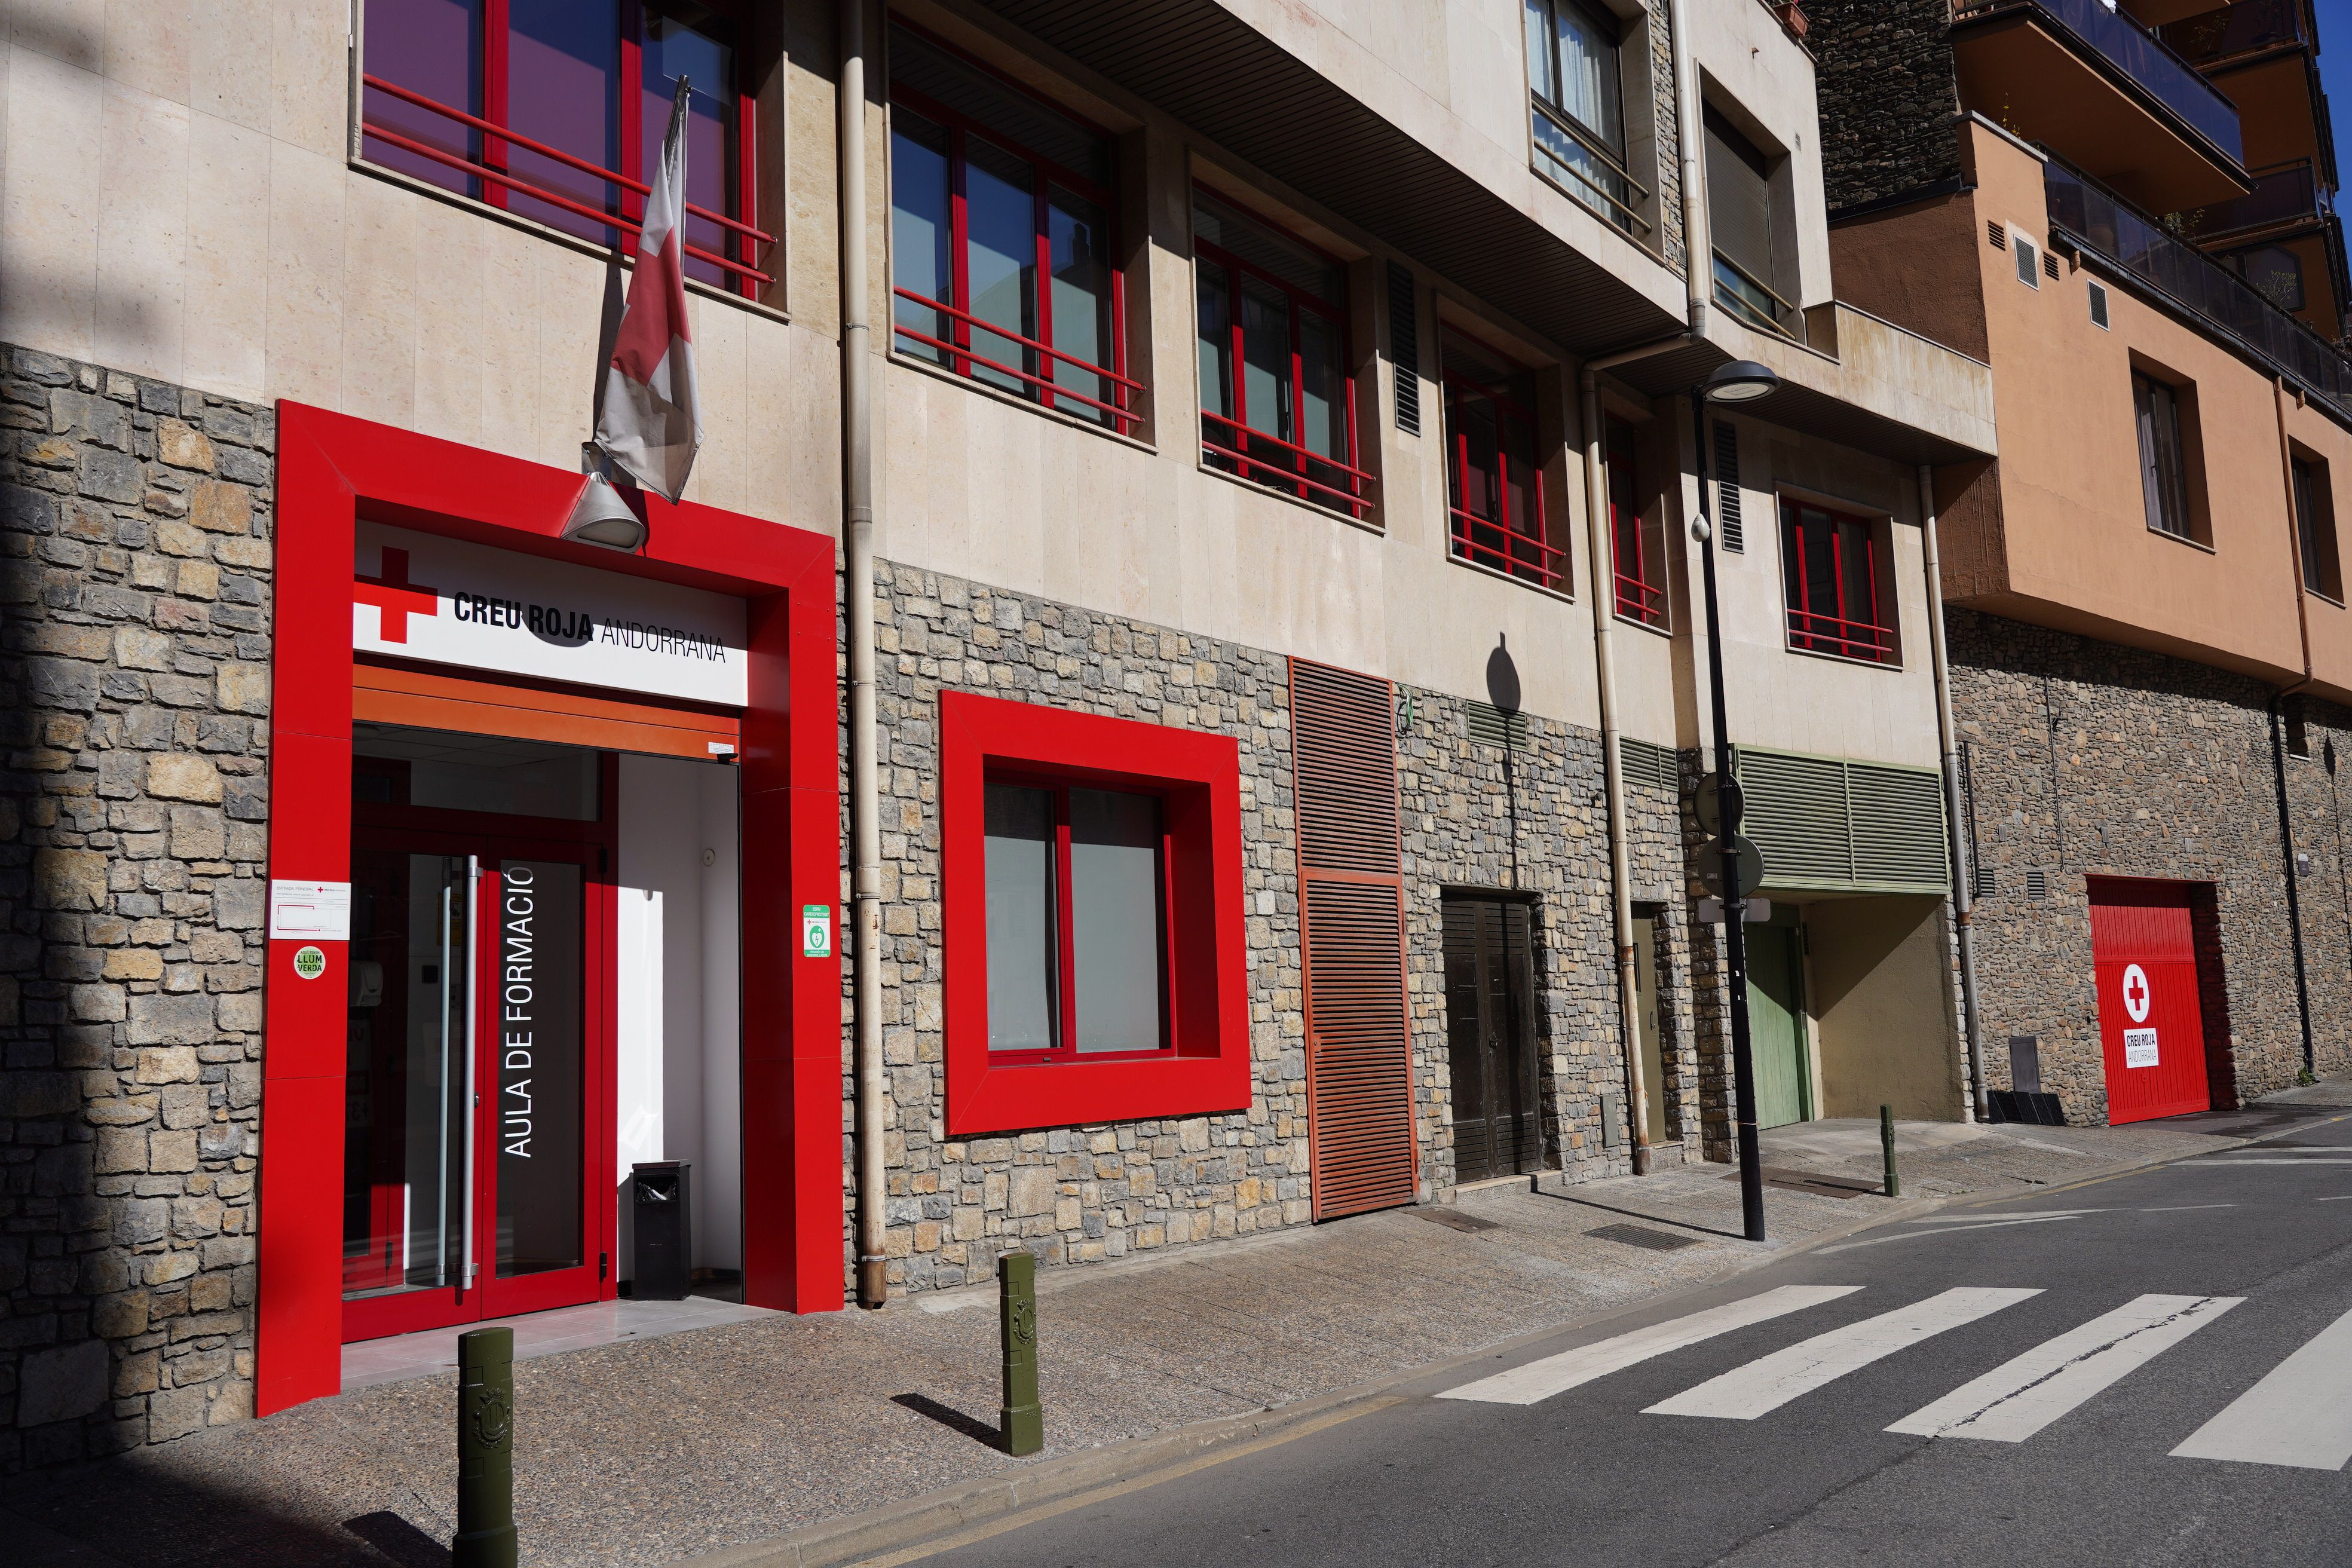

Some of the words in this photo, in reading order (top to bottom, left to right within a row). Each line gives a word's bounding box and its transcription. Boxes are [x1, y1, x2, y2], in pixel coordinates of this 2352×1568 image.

[454, 592, 521, 629] CREU
[528, 604, 594, 641] ROJA
[601, 617, 726, 663] ANDORRANA
[297, 955, 322, 963] LLUM
[501, 866, 534, 1021] FORMACIÓ
[506, 1031, 532, 1070] DE
[2127, 1035, 2141, 1047] CREU
[2141, 1033, 2155, 1046] ROJA
[2129, 1049, 2157, 1062] ANDORRANA
[505, 1078, 531, 1158] AULA
